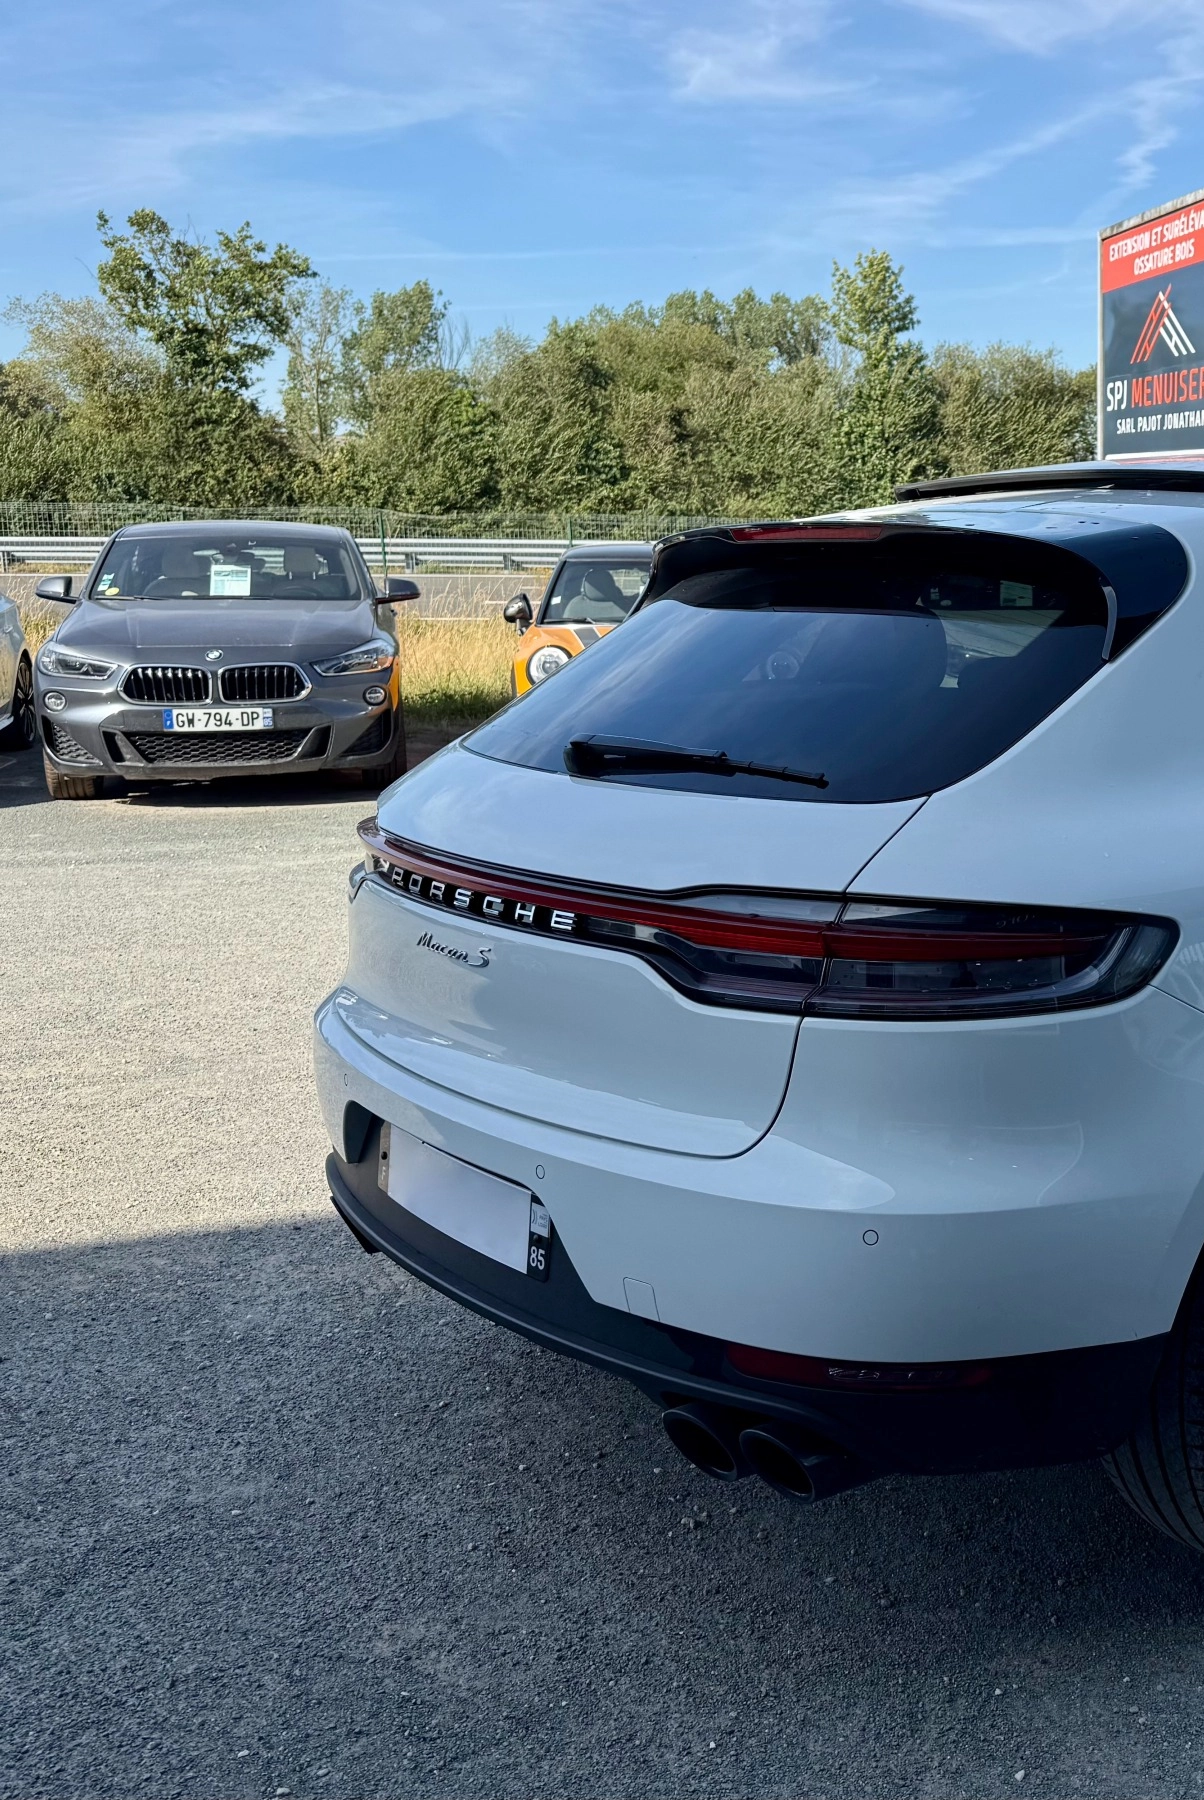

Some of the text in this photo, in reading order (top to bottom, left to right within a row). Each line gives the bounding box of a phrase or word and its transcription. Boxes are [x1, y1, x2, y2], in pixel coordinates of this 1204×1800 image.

[1109, 230, 1151, 262] EXTENSION
[1151, 226, 1163, 246] ET
[1133, 238, 1195, 275] OSSATURE BOIS
[1106, 380, 1128, 412] SPJ
[1116, 418, 1136, 434] SARL
[1137, 414, 1162, 433] PAJOT
[175, 711, 260, 728] GW-794-DP
[391, 866, 575, 931] PORSCHE
[417, 931, 491, 967] Macan S
[529, 1246, 546, 1270] 85
